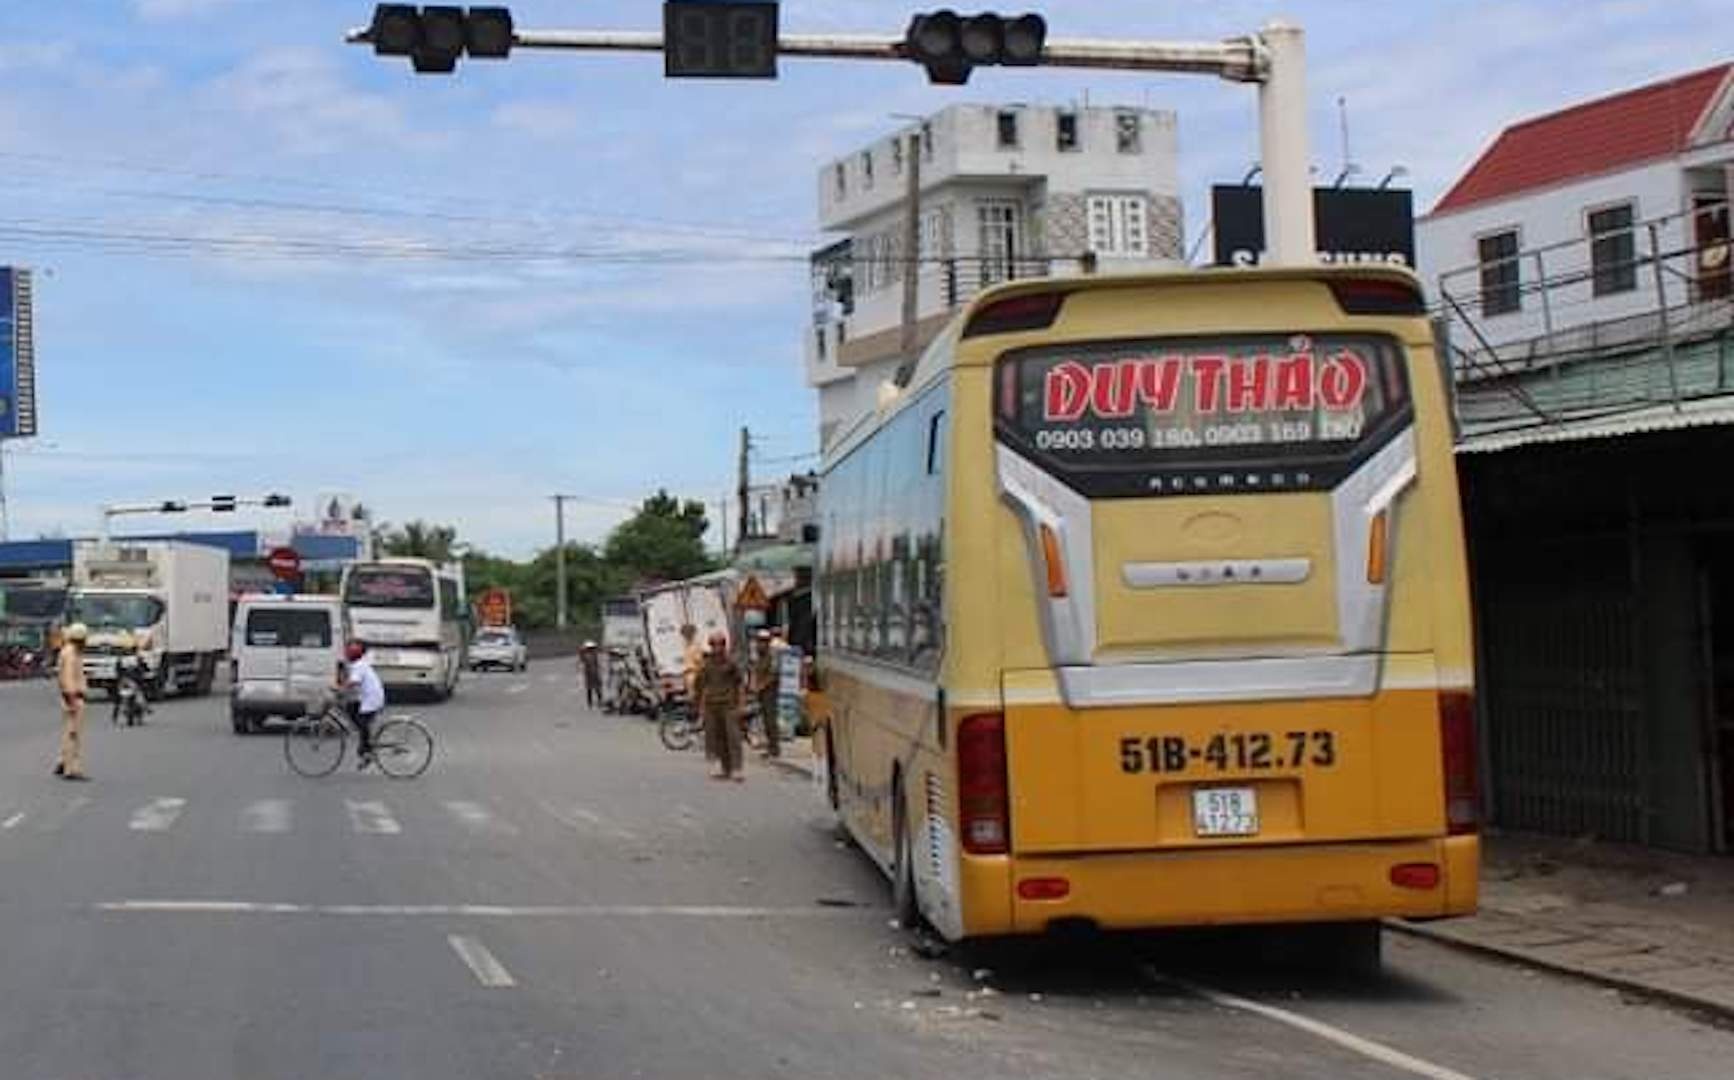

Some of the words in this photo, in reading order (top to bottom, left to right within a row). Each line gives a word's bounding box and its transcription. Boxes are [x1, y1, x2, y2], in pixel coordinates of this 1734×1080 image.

[1036, 428, 1095, 449] 0903
[1101, 427, 1146, 448] 039
[1120, 730, 1335, 774] 51B-412.73
